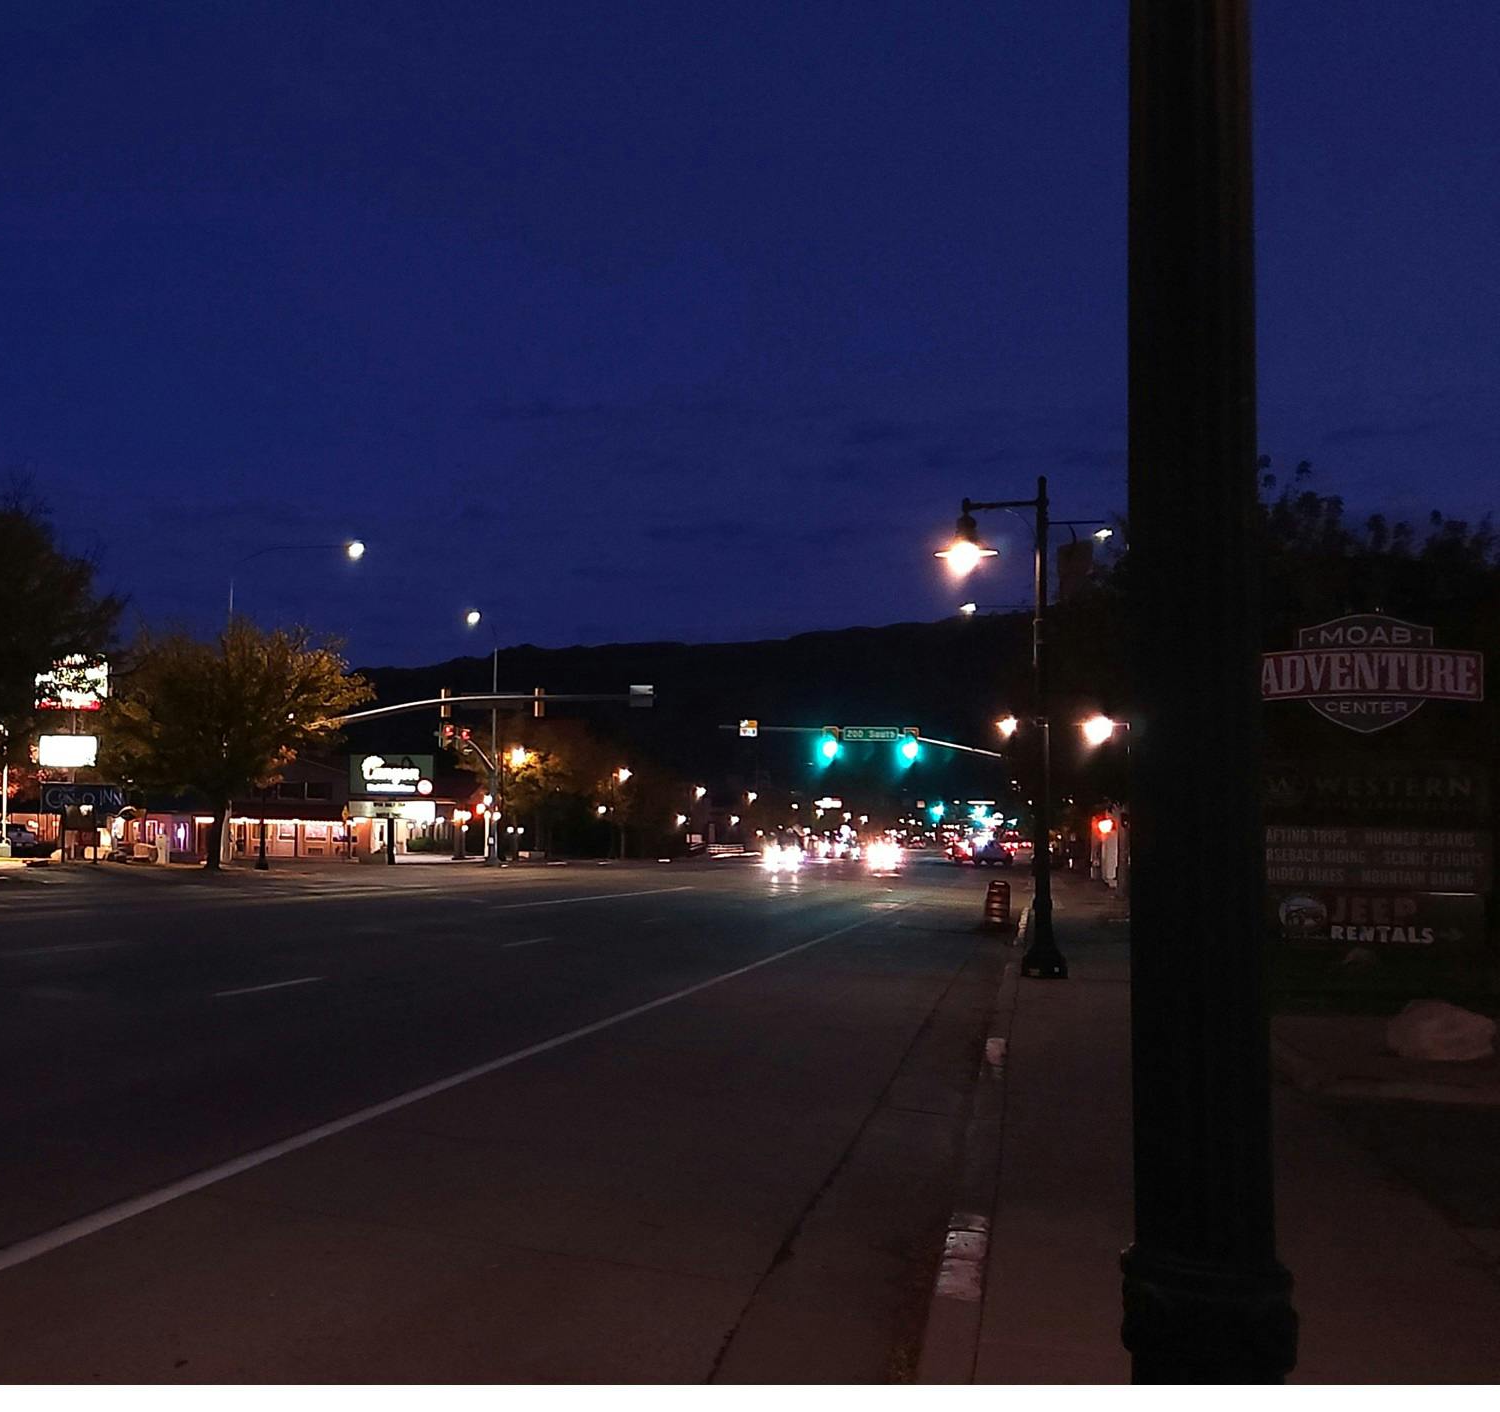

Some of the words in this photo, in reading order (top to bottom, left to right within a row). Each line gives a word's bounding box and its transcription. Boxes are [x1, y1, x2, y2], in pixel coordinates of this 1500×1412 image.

[1319, 626, 1412, 645] MOAB
[1261, 652, 1478, 695] ADVENTURE
[1324, 701, 1409, 714] CENTER
[846, 730, 864, 738] 200
[867, 730, 896, 738] South
[1266, 829, 1309, 844] AFTING
[1267, 867, 1304, 881] UIDED
[1333, 896, 1417, 924] JEEP
[1330, 925, 1435, 945] RENTALS
